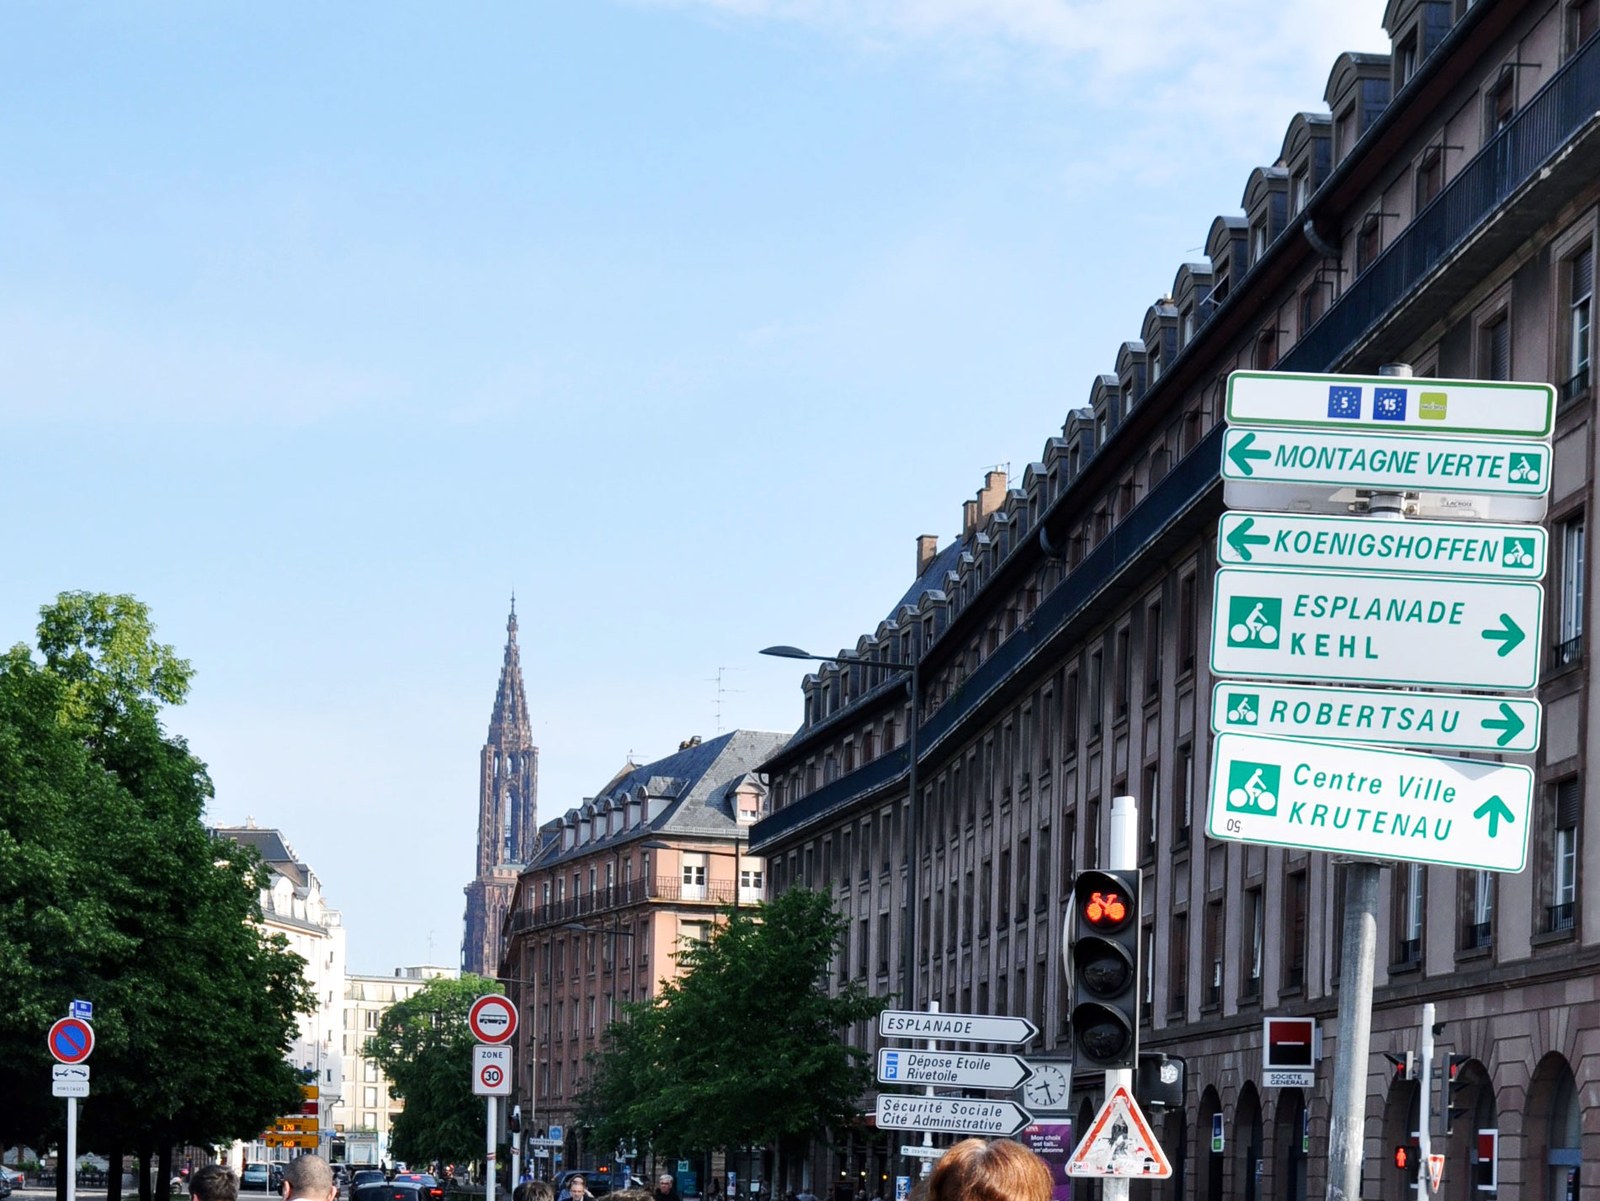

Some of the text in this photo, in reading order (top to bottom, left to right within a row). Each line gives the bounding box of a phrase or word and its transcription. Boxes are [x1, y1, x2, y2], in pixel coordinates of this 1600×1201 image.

[1341, 396, 1397, 411] 5 15
[1274, 444, 1505, 479] MONTAGNE VERTE
[1273, 529, 1499, 563] KOENIGSHOFFEN
[1292, 594, 1466, 625] ESPLANADE
[1290, 632, 1379, 660] KEHL
[1269, 700, 1461, 733] ROBERTSAU
[1293, 762, 1457, 804] Centre Ville
[1288, 801, 1453, 842] KRUTENAU
[887, 1017, 973, 1034] ESPLANADE
[481, 1051, 504, 1059] ZONE
[907, 1054, 991, 1071] Dépose Etoile
[485, 1070, 500, 1082] 30
[906, 1067, 958, 1082] Rivetoile
[883, 1098, 1003, 1117] Sécurité Sociale
[882, 1112, 1003, 1131] Cité Administrative
